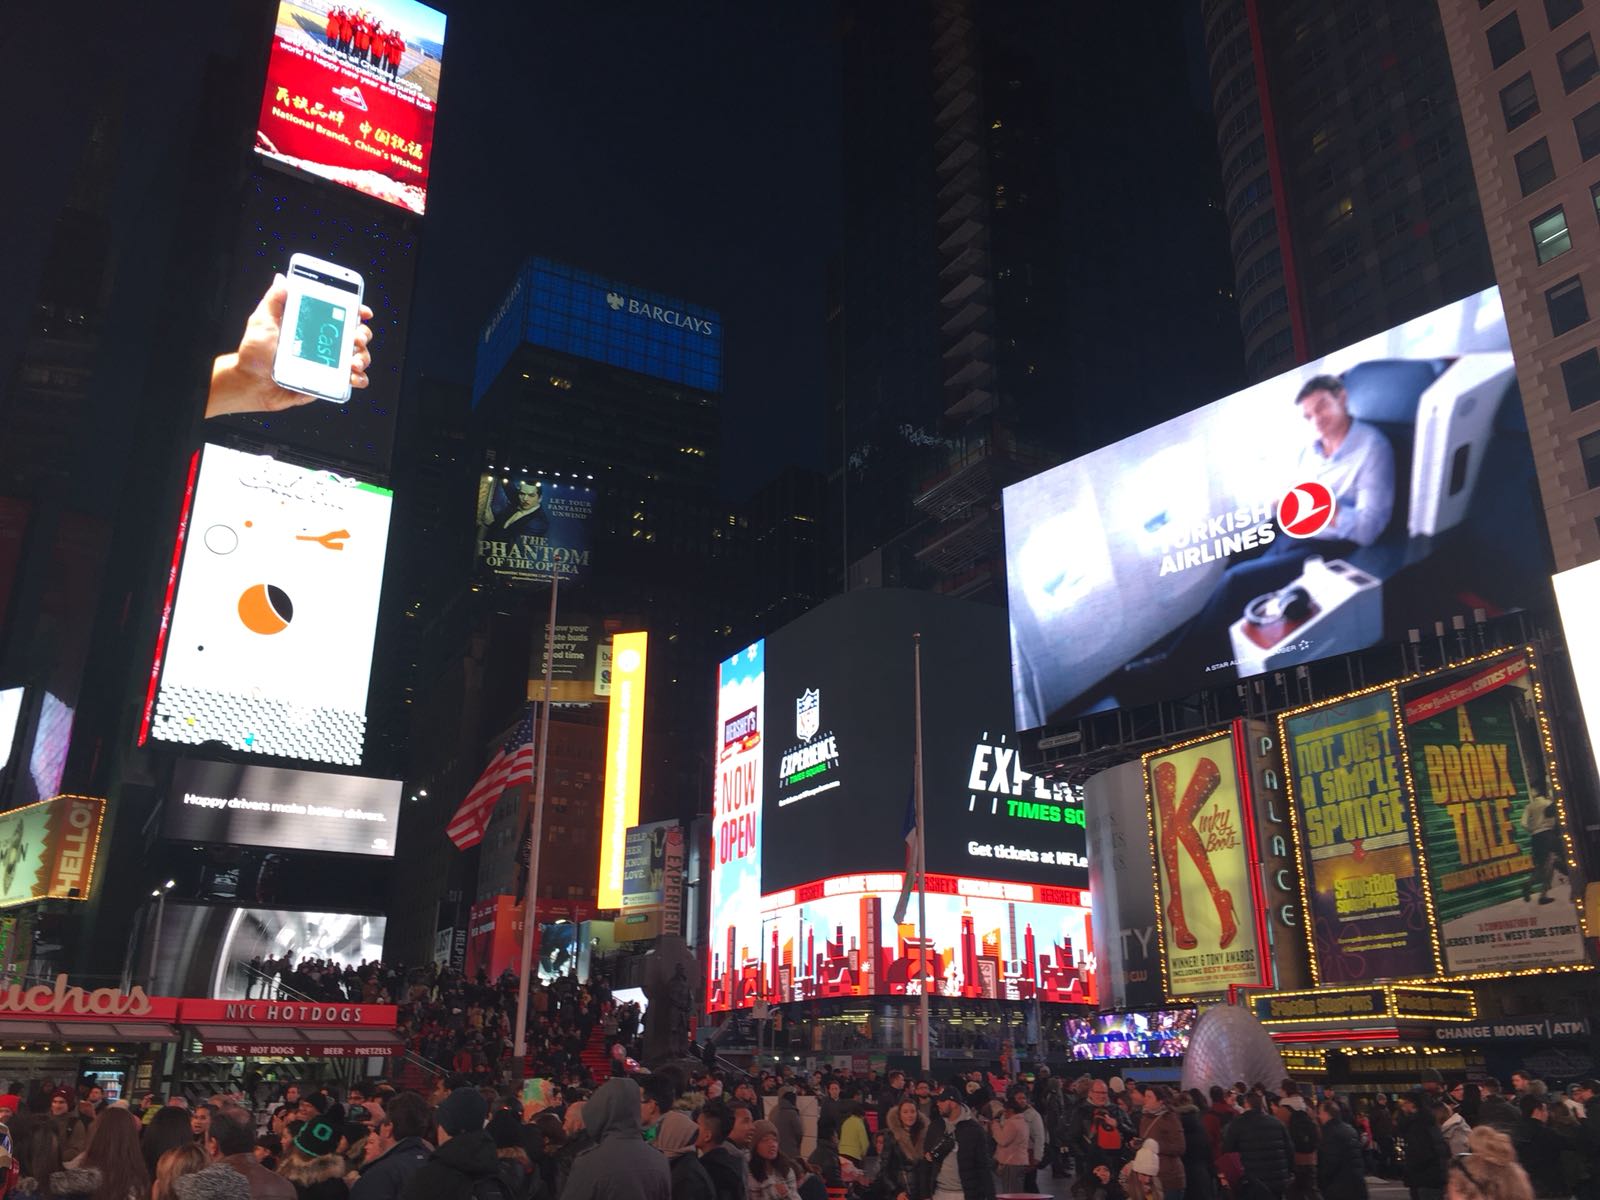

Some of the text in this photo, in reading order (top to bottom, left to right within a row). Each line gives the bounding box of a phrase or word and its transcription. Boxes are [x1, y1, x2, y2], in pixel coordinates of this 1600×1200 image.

[313, 54, 340, 73] happy
[340, 68, 359, 80] new
[360, 75, 379, 89] year
[380, 84, 396, 95] and
[397, 90, 415, 104] best
[416, 99, 432, 112] luck
[272, 106, 315, 130] National
[354, 139, 390, 160] China's
[391, 153, 423, 174] Wishes
[628, 299, 714, 336] BARCLAYS
[480, 540, 591, 566] PHANTOM
[520, 535, 549, 547] THE
[1159, 523, 1276, 576] AIRLINES
[487, 556, 580, 574] OF THE OPERA
[545, 624, 590, 633] Sow your
[545, 633, 566, 642] tste
[543, 652, 564, 661] god
[1211, 661, 1230, 671] STAR
[1506, 659, 1527, 676] PICK
[1457, 704, 1475, 742] A
[779, 736, 840, 779] EXPERIENCE
[1296, 721, 1392, 777] NOT JUST
[722, 759, 757, 815] NOW
[1300, 755, 1401, 810] A SIMPLE
[1424, 743, 1517, 805] BRONX
[183, 793, 229, 811] Happy
[228, 797, 271, 812] drivers
[271, 803, 306, 815] make
[344, 808, 387, 823] drivers.
[1007, 799, 1062, 823] TIMES
[1305, 789, 1409, 848] SPONGE
[720, 811, 757, 865] OPEN
[1206, 831, 1241, 853] Boots
[1261, 736, 1297, 927] PALACE
[1447, 798, 1520, 865] TALE
[55, 801, 94, 897] HELLO!
[968, 841, 993, 858] Get
[994, 842, 1040, 863] tickets
[1040, 851, 1056, 866] at
[625, 869, 646, 880] LOVE
[1120, 926, 1154, 960] TY
[1446, 936, 1474, 948] JERSEY
[1474, 933, 1497, 945] BOYS
[1504, 930, 1528, 941] WEST
[1529, 927, 1548, 937] SIDE
[1172, 962, 1256, 977] INCLUDING BEST MUSICAL
[1206, 953, 1224, 966] TONY
[1226, 949, 1255, 962] AWARDS
[226, 1003, 257, 1020] NYC
[1435, 1022, 1586, 1040] CHANGE MONEY ATM
[215, 1045, 392, 1056] WINE HOT DOGS BEER PRETZELS
